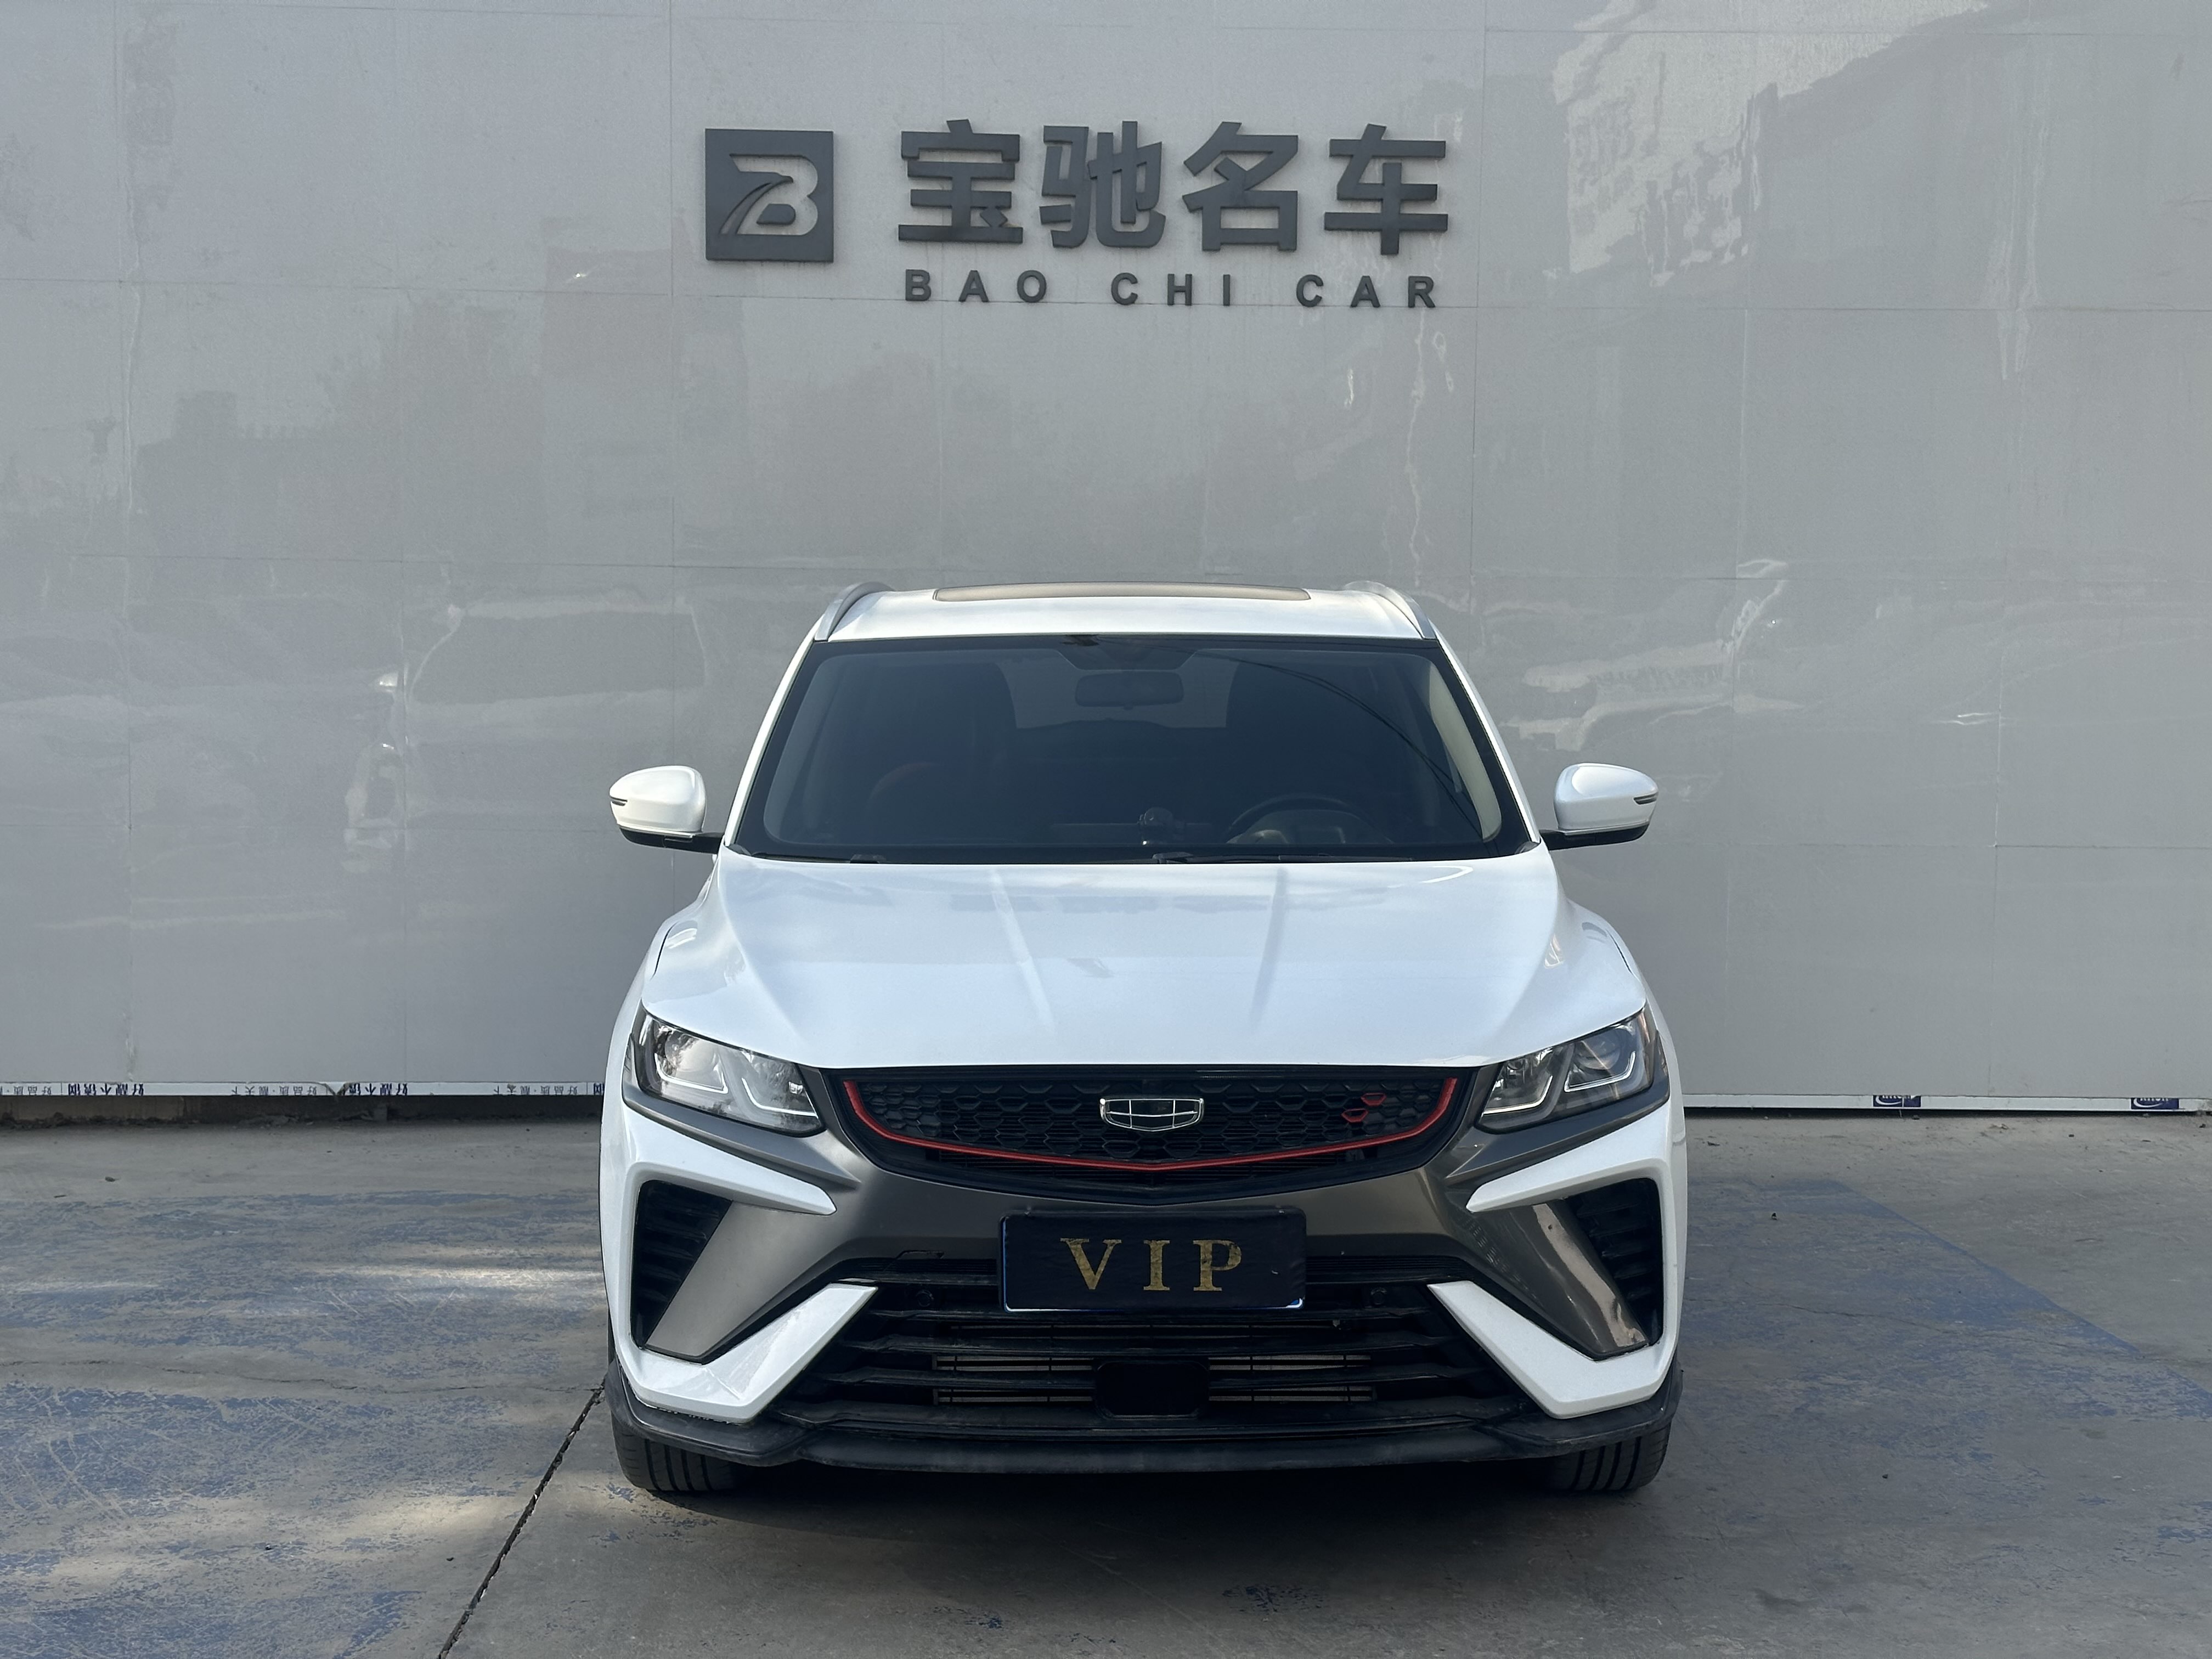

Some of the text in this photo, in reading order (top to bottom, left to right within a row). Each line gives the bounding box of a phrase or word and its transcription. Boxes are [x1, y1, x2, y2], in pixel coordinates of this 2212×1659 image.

[898, 119, 1448, 256] 宝驰名车
[905, 269, 1436, 309] BAO CHI CAR
[1060, 1238, 1243, 1291] VIP
